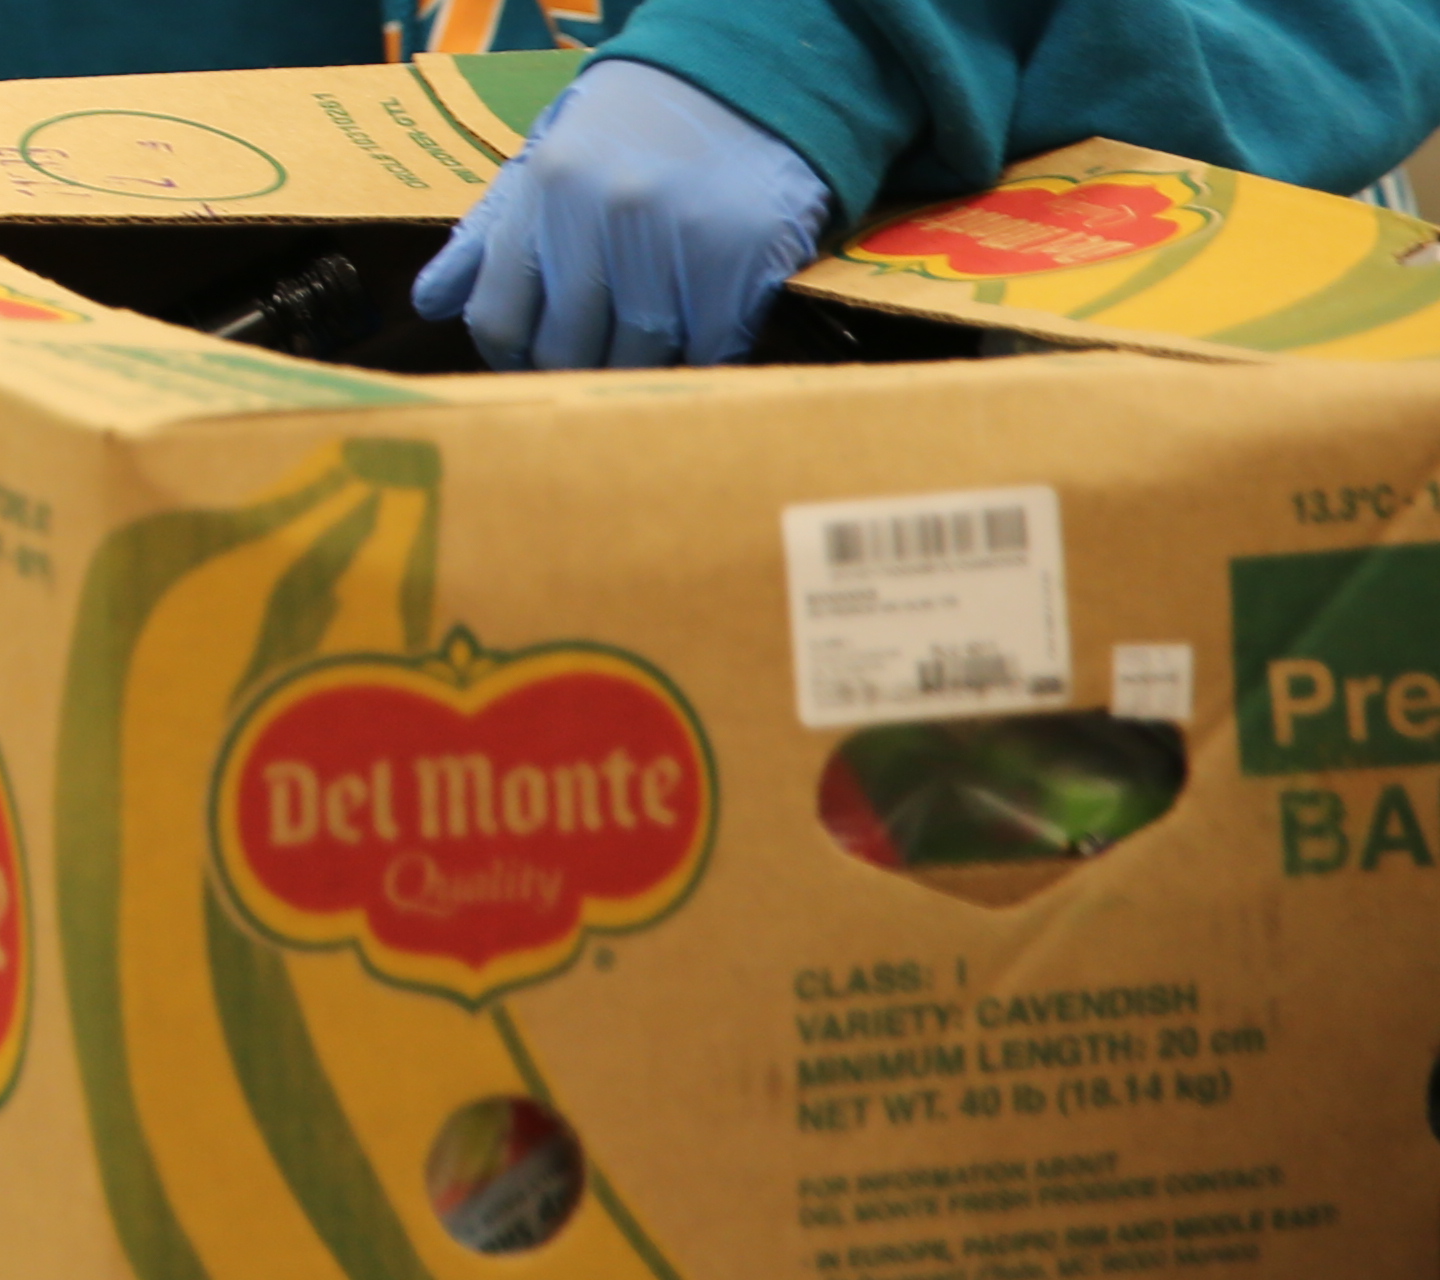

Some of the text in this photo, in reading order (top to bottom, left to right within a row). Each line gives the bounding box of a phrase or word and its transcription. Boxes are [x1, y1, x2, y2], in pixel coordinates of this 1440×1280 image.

[264, 748, 681, 846] Del Monte
[384, 850, 563, 918] Quality
[794, 960, 934, 1002] CLASS:
[796, 983, 1199, 1047] VARIETY: CAVENDISH
[797, 1027, 1268, 1092] MINIMUM LENGTH: 20 cm
[797, 1094, 870, 1135] NET
[884, 1086, 948, 1125] WT.
